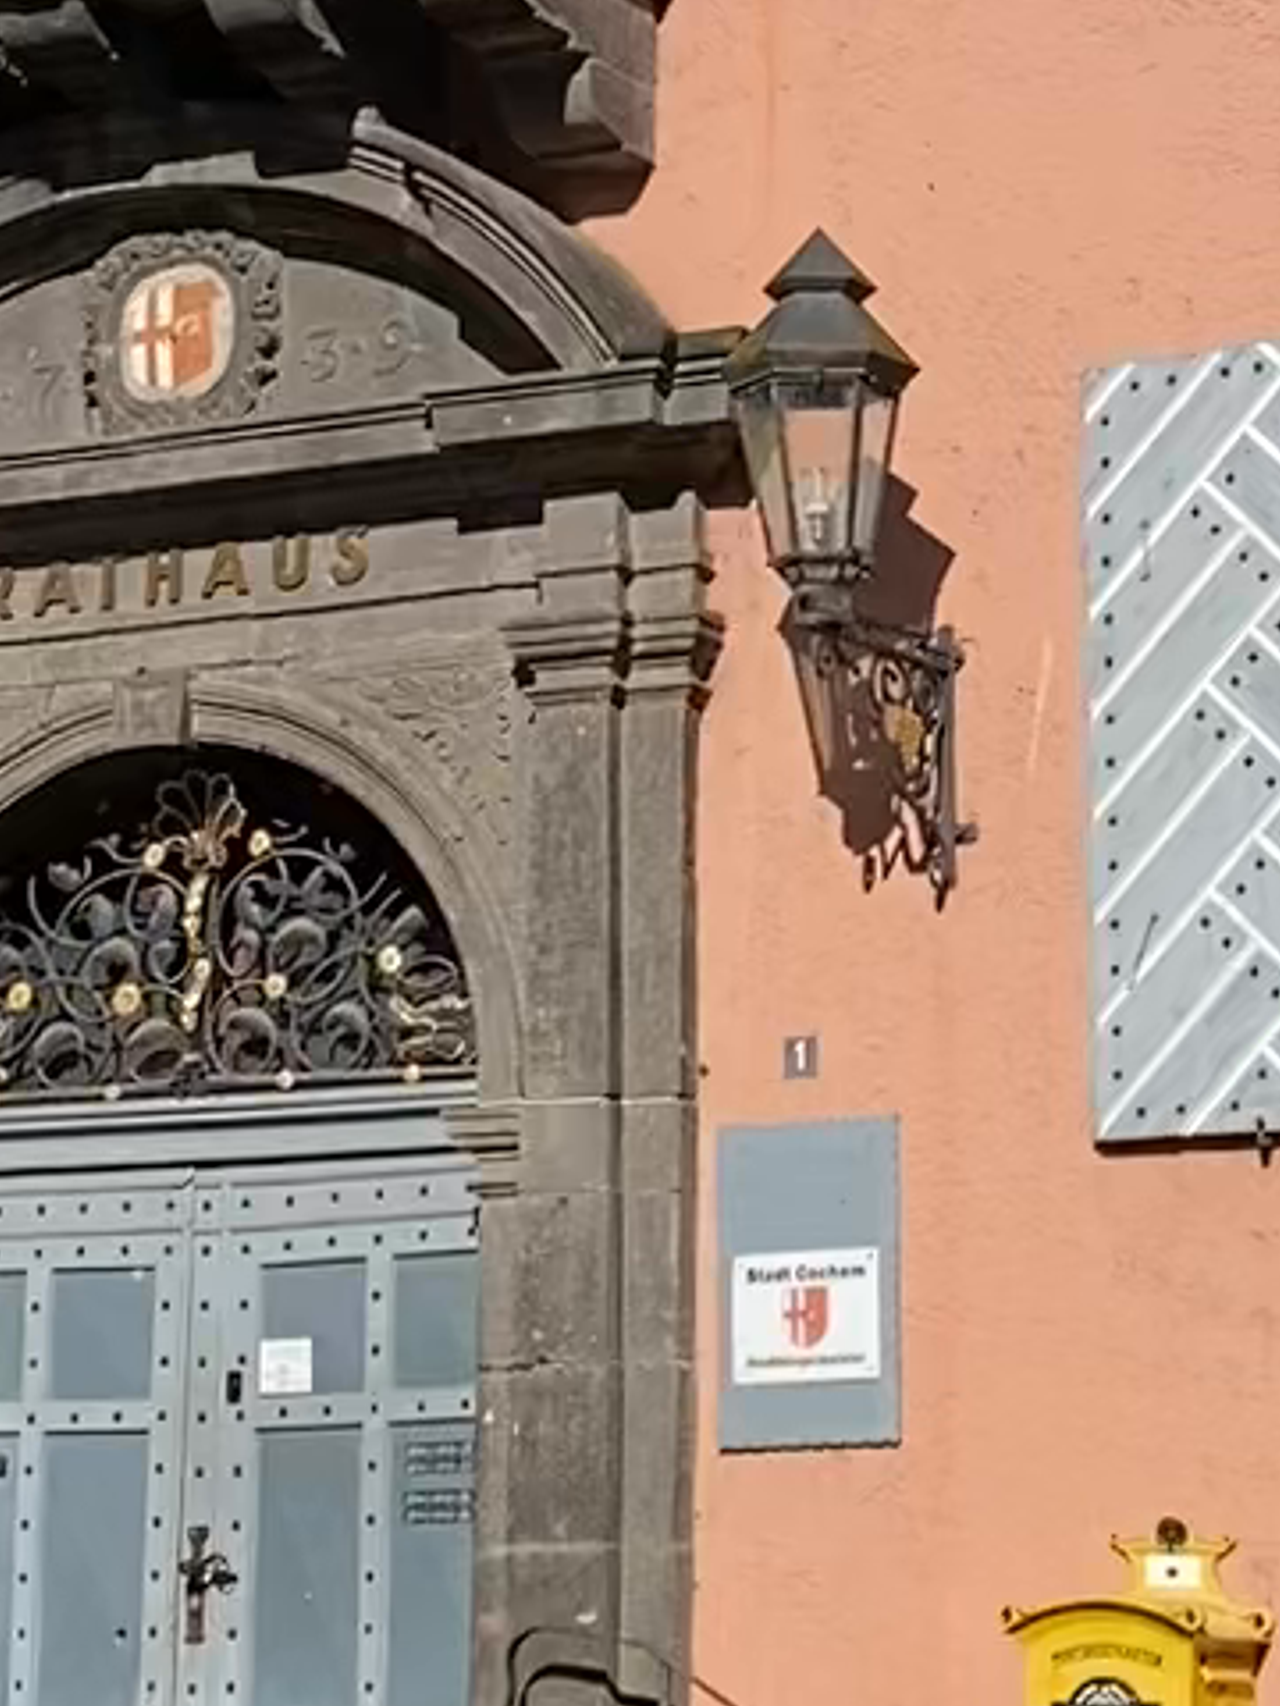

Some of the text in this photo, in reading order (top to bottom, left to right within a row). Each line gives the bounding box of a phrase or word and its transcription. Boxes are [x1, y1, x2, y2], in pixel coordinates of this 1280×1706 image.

[793, 1038, 806, 1071] 1
[746, 1263, 867, 1284] Stadt Cochem
